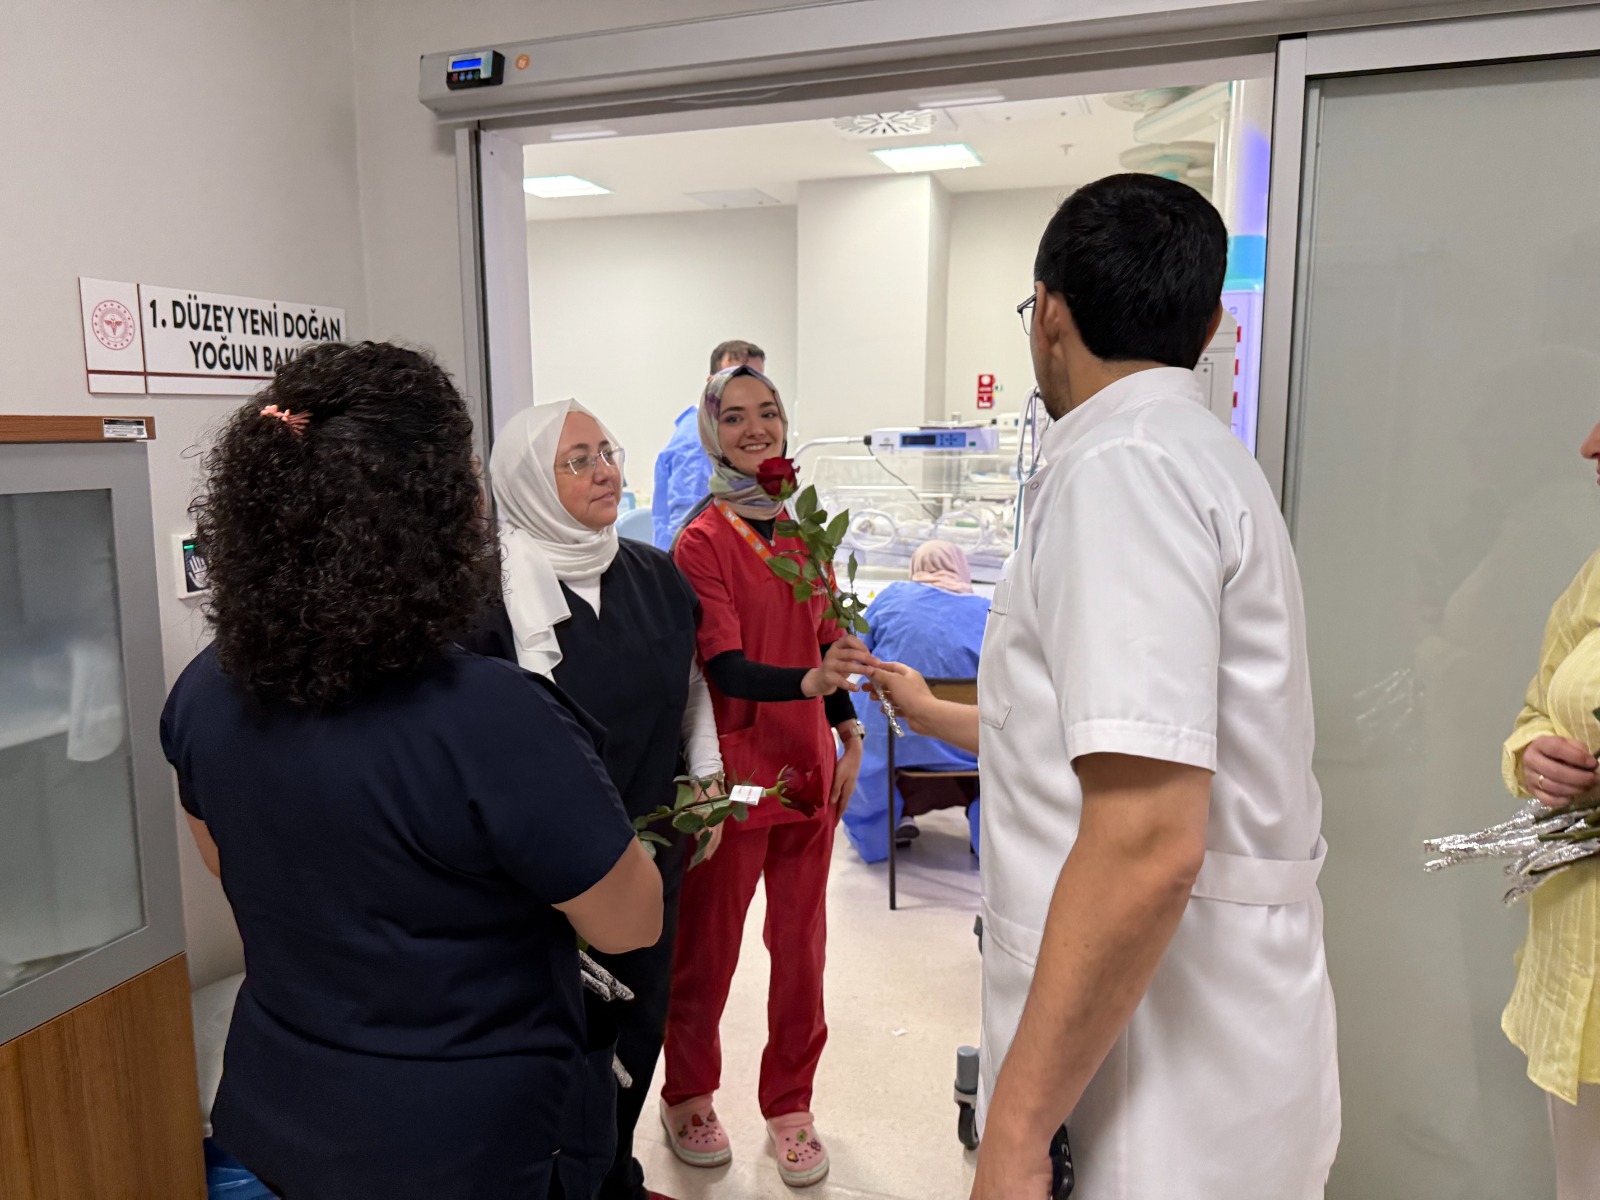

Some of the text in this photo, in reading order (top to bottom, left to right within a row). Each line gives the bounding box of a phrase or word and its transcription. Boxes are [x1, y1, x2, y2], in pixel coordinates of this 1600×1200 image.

[149, 299, 167, 328] 1.
[172, 294, 234, 333] DÜZEY
[238, 302, 279, 337] YENİ
[284, 308, 341, 341] DOĞAN
[189, 335, 300, 372] YOĞUN BAK
